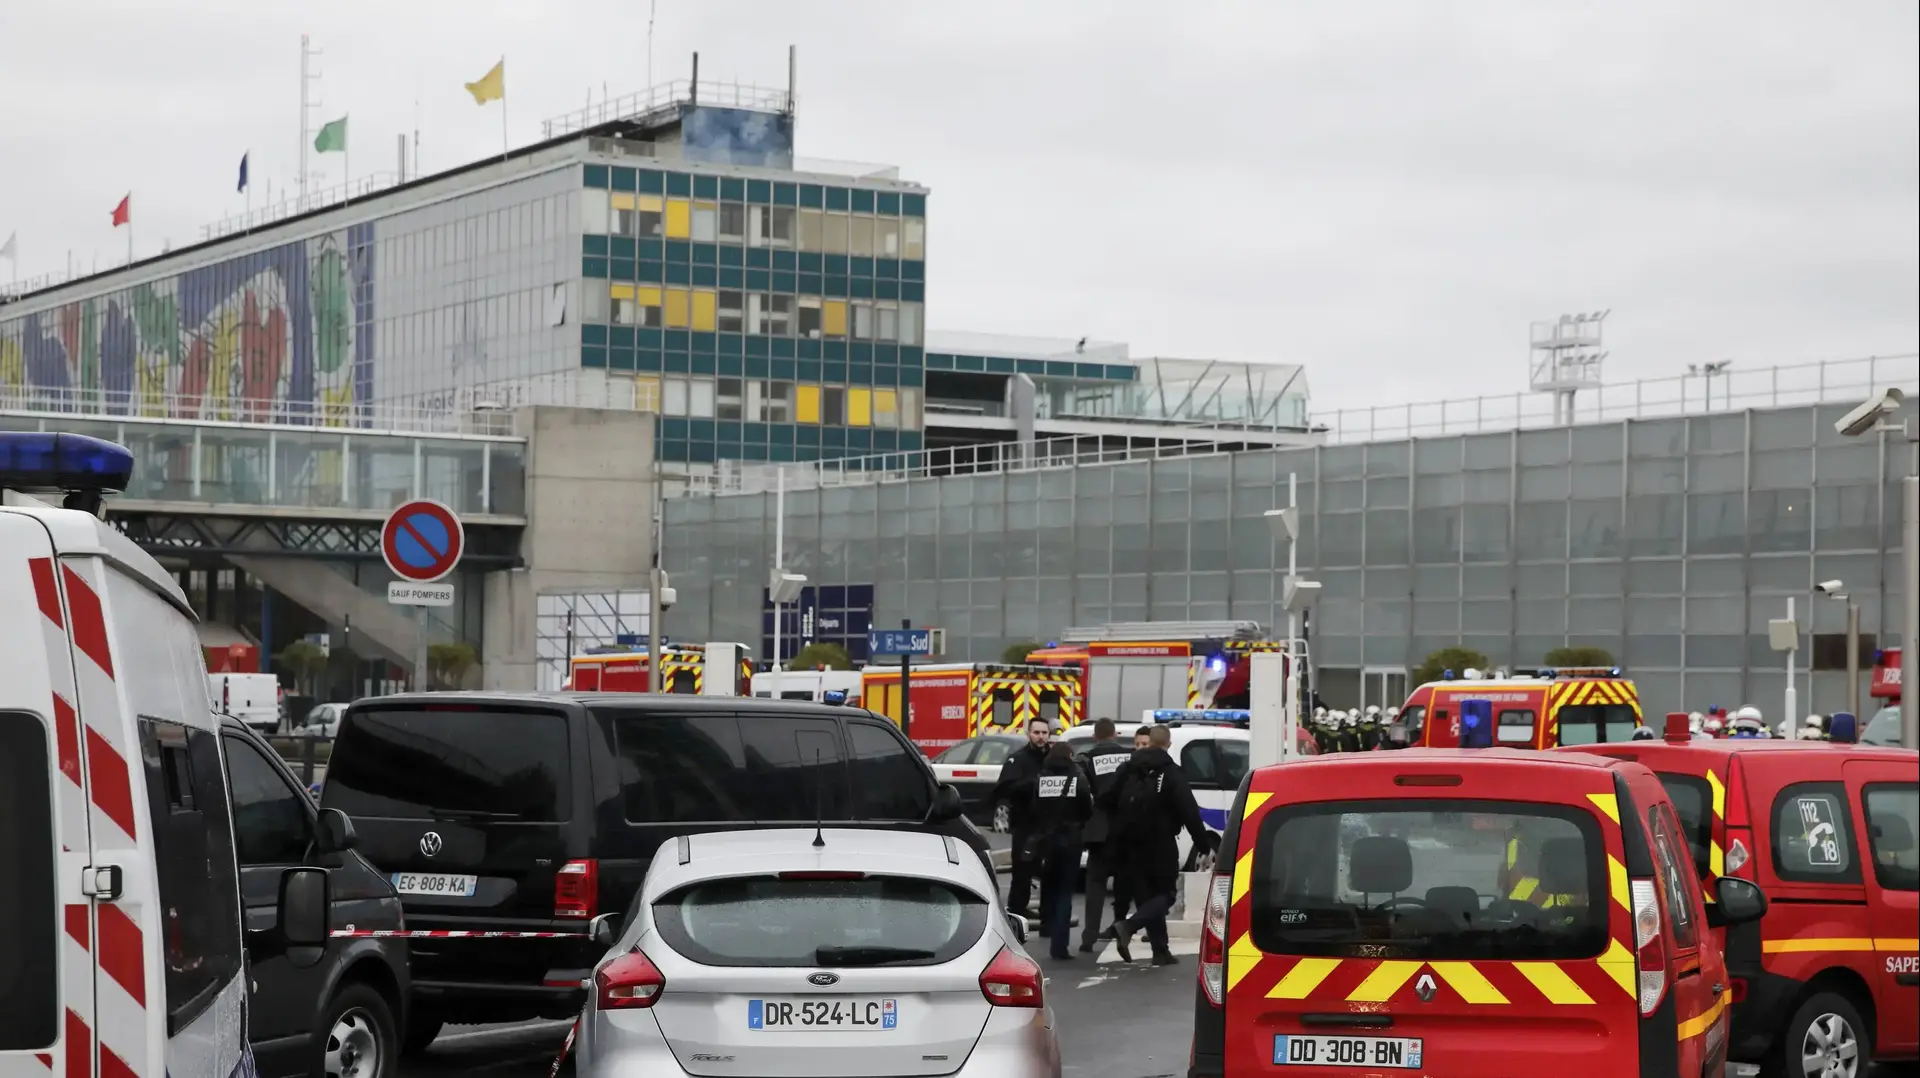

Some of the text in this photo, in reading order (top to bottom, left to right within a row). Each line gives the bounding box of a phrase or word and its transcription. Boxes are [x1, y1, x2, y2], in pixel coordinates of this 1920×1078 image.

[391, 589, 451, 600] SAUF POMPIERS
[911, 633, 929, 650] Sud
[1801, 802, 1820, 823] 112
[1820, 840, 1838, 862] 18
[399, 875, 466, 893] EG-808-KA
[1280, 913, 1297, 922] elf
[765, 1002, 880, 1026] DR-524-LC
[884, 1015, 895, 1025] 75
[1277, 1039, 1421, 1066] F DD-308-BN 75
